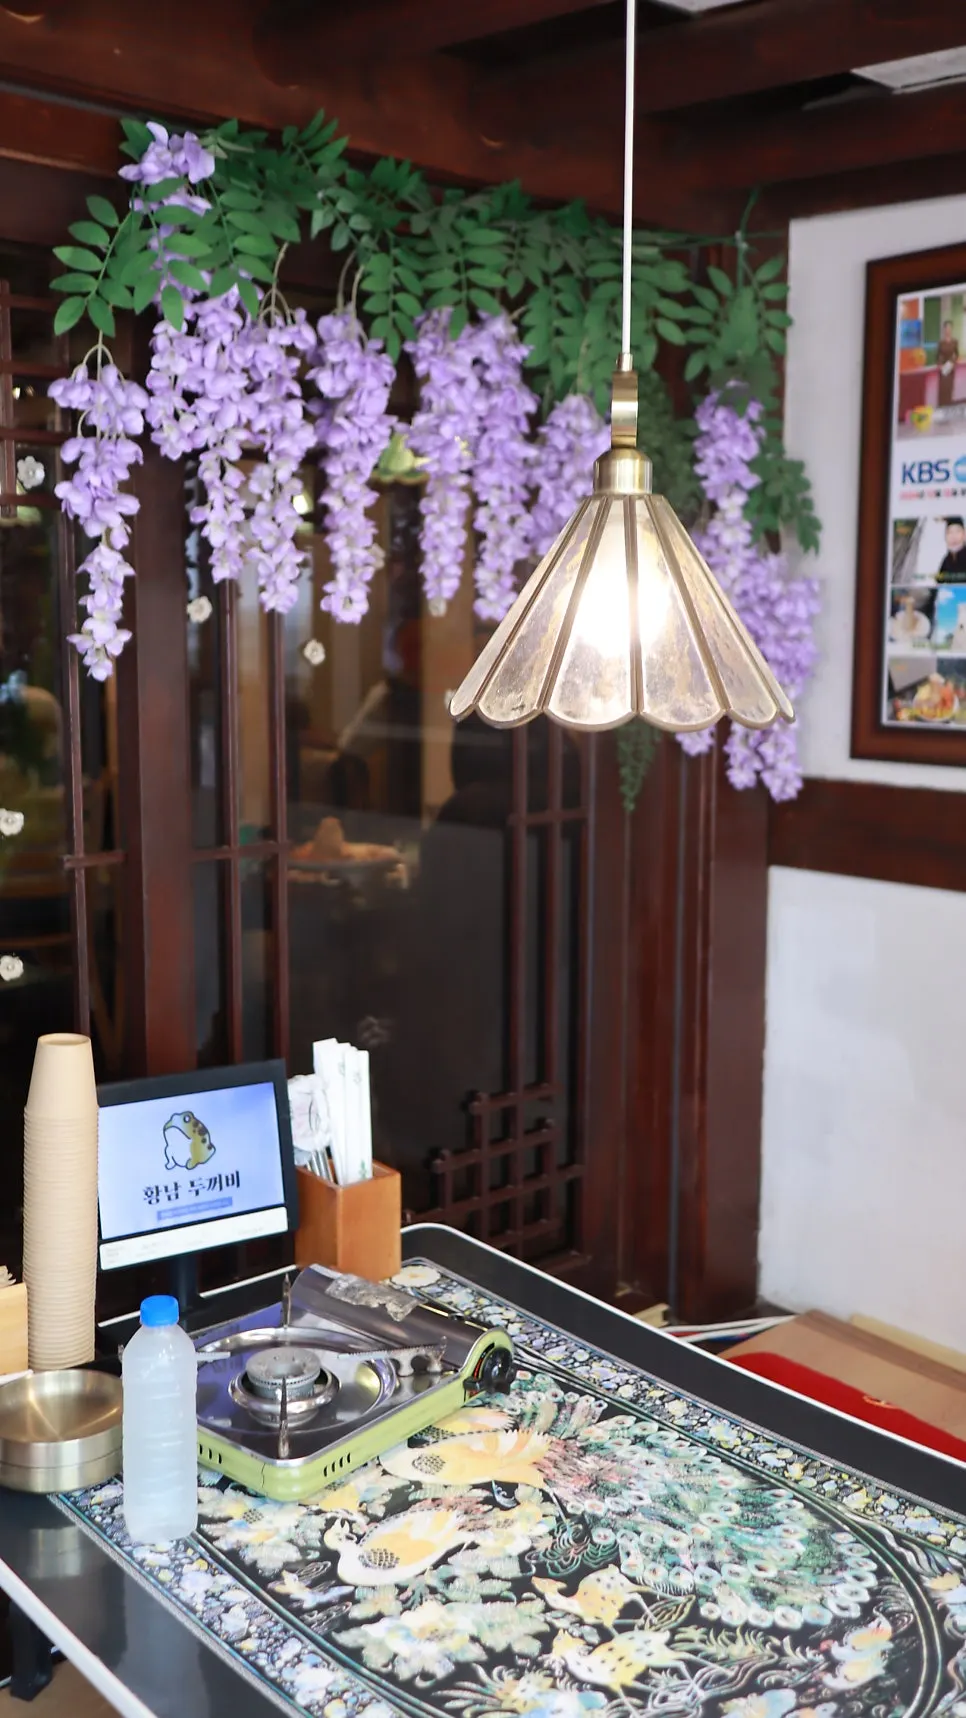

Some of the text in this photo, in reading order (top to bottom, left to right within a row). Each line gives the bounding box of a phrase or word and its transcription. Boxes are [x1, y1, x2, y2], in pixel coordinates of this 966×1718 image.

[902, 459, 950, 484] KBS
[143, 1170, 240, 1205] 황남 두꺼비
